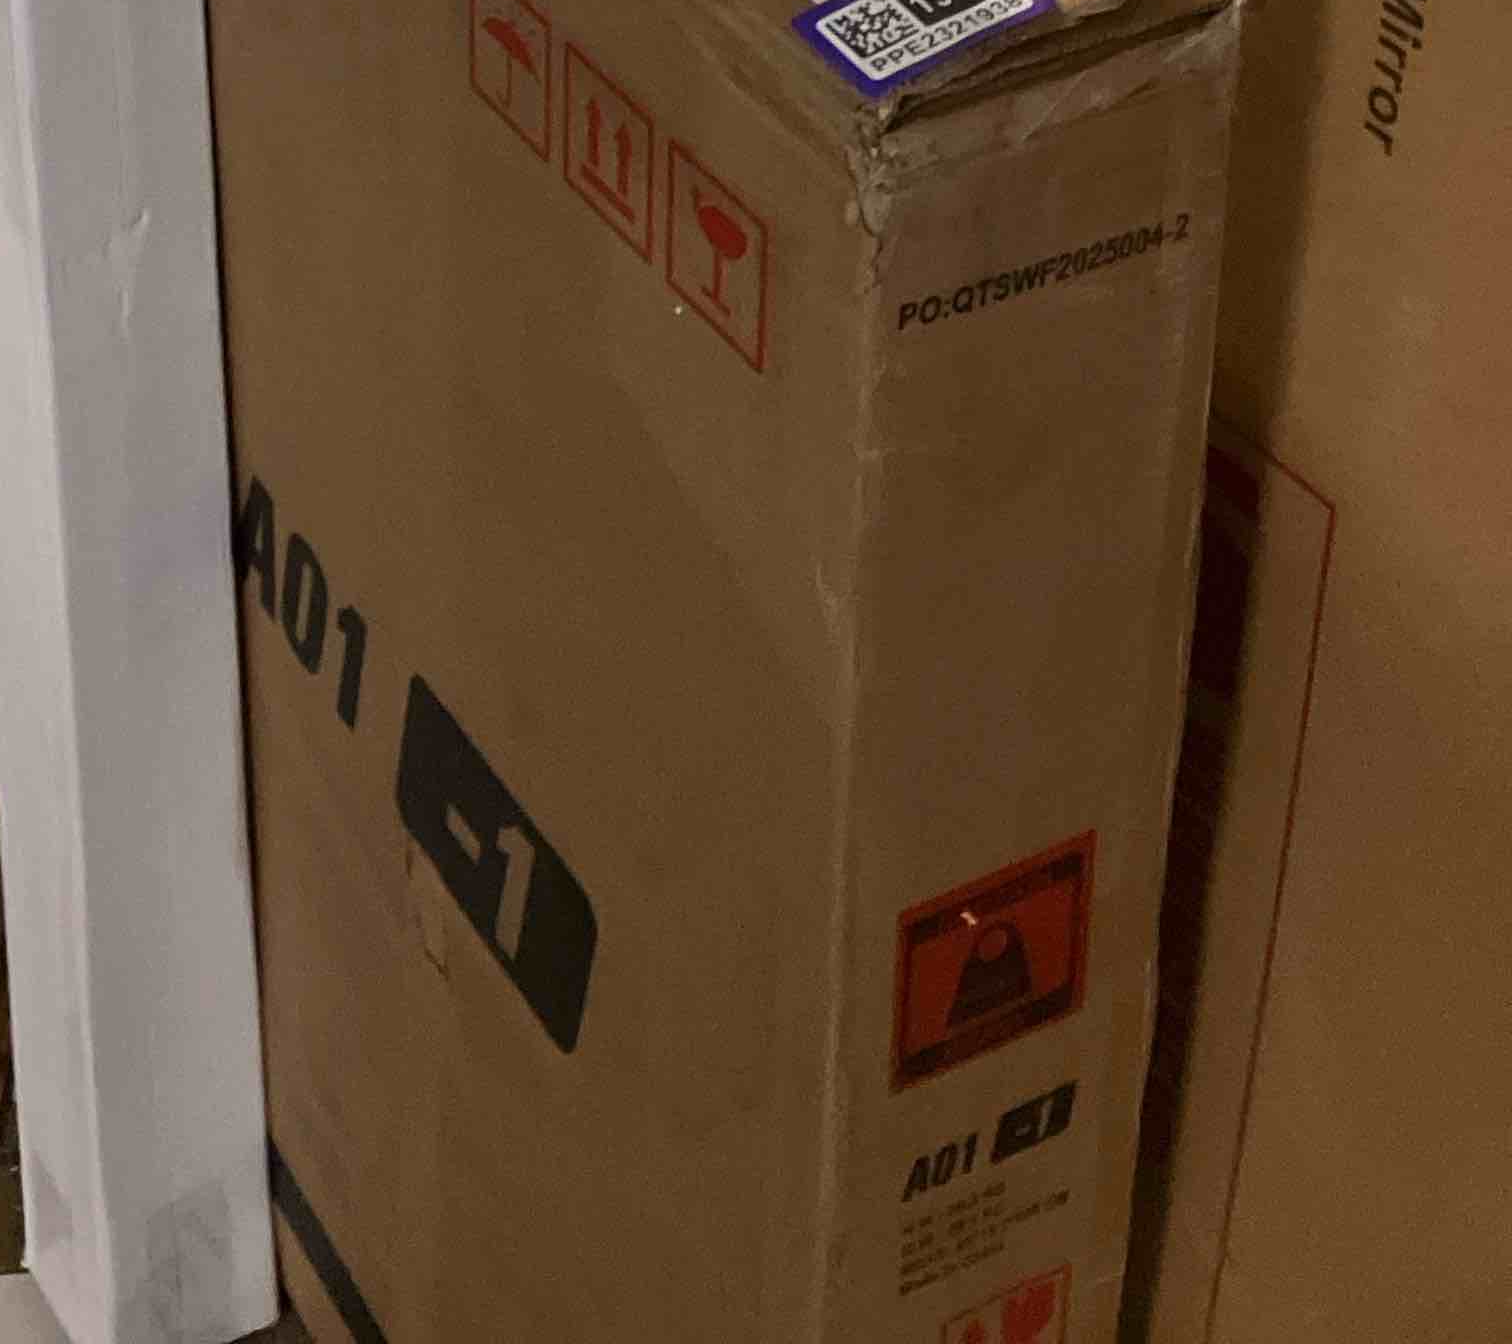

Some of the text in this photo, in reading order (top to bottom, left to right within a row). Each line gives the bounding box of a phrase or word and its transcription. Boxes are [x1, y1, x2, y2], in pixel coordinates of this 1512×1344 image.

[897, 213, 1190, 331] PO:QTSWF2025004-2
[234, 474, 367, 731] A01
[900, 1131, 979, 1203] A01
